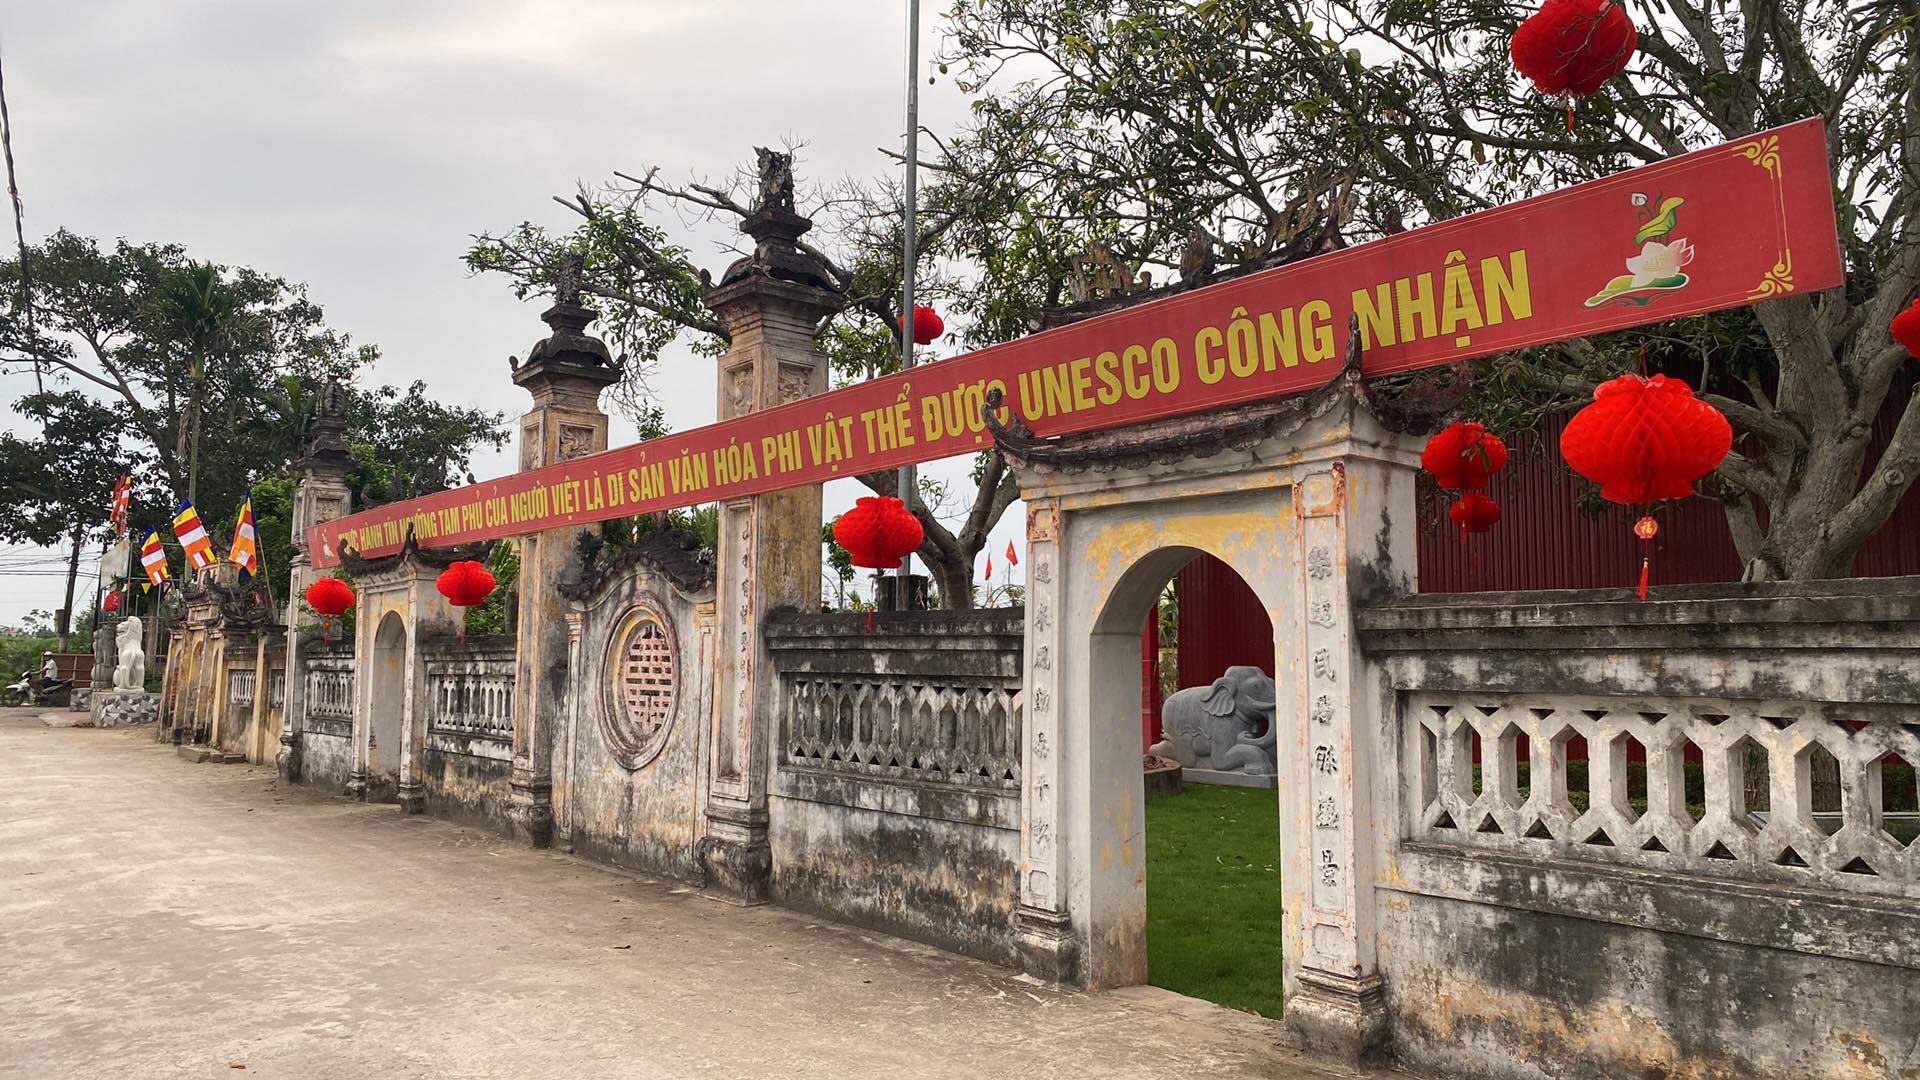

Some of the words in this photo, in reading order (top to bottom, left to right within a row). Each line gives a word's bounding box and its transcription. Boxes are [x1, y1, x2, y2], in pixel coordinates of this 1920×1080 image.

[360, 521, 383, 551] HÀNH
[383, 516, 400, 546] TÍN
[438, 507, 461, 536] TAM
[462, 489, 484, 532] PHỦ
[485, 485, 508, 529] CỦA
[510, 480, 549, 523] NGƯỜI
[551, 475, 581, 521] VIỆT
[584, 470, 604, 512] LÀ
[607, 473, 625, 507] DI
[628, 451, 666, 503] SẢN
[667, 447, 709, 495] VĂN
[712, 436, 759, 487] HÓA
[761, 429, 802, 477] PHI
[806, 411, 854, 472] VẬT
[860, 382, 916, 454] THỂ
[921, 378, 1010, 445] ĐƯỢC
[1018, 336, 1181, 421] UNESCO
[1194, 306, 1336, 379] CÔNG
[1351, 248, 1534, 351] NHẬN
